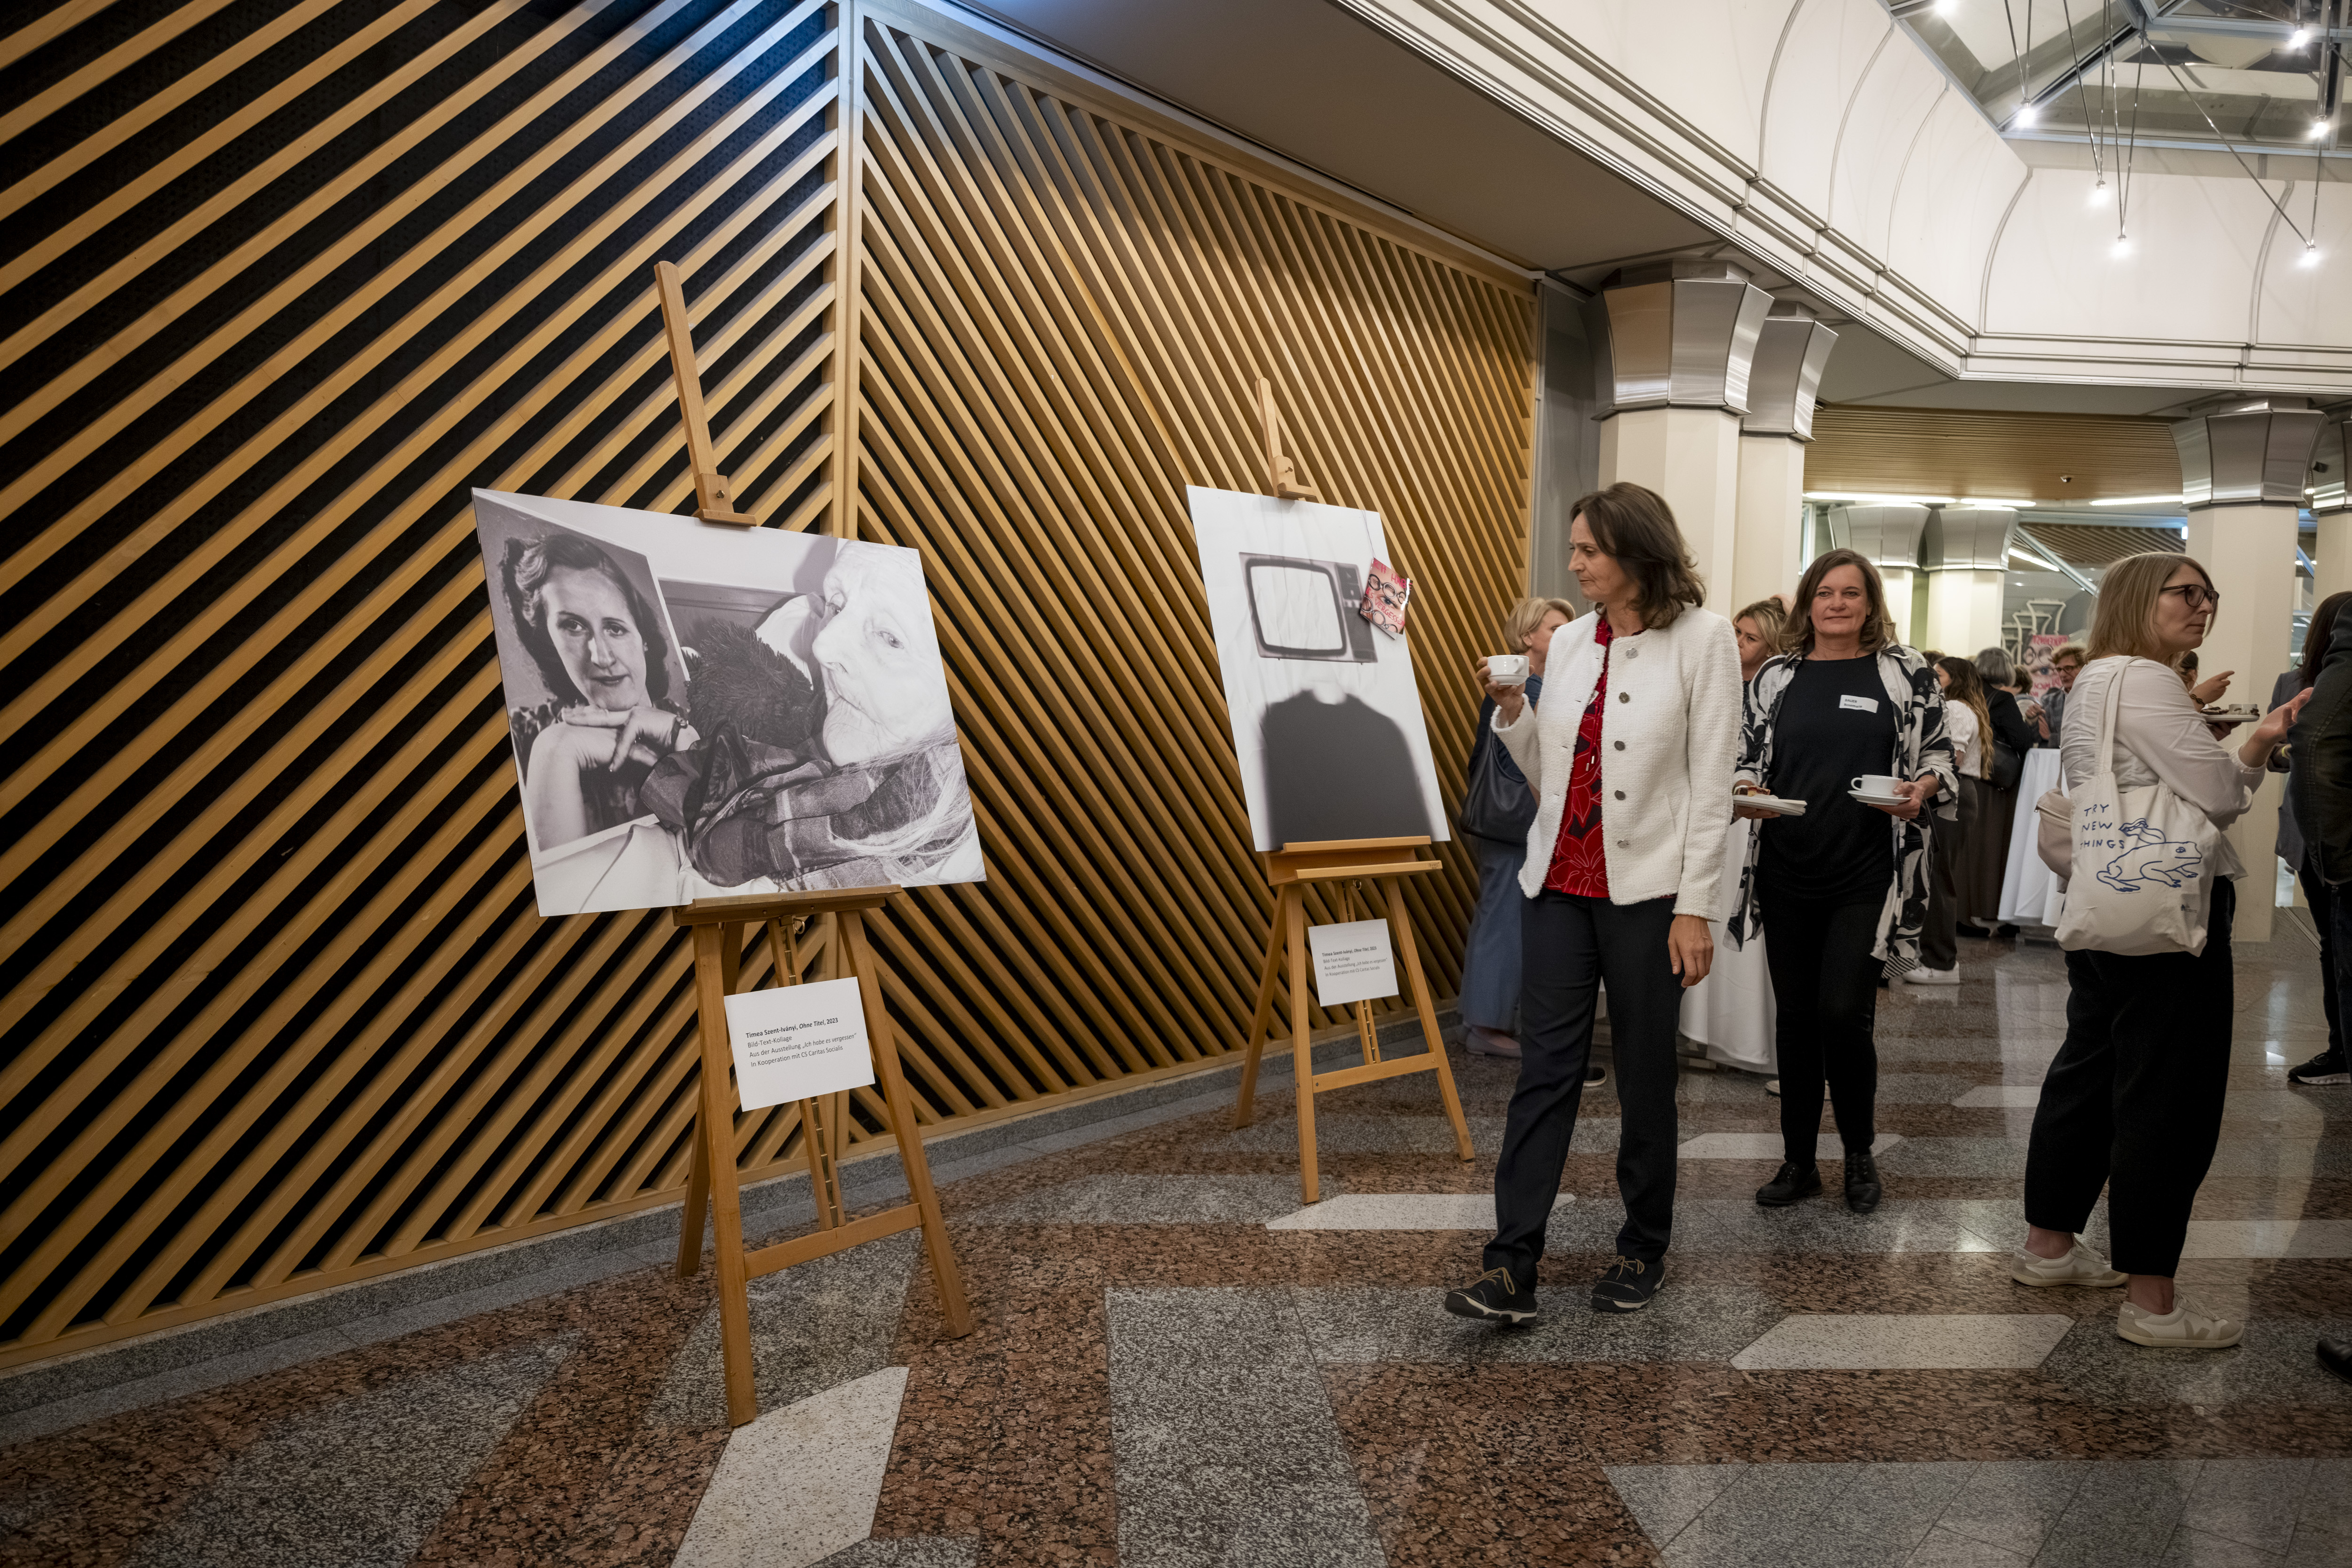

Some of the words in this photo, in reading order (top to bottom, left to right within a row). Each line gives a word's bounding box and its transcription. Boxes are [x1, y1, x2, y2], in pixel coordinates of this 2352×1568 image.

[1366, 587, 1375, 598] ES
[1375, 597, 1405, 627] VERGESSEN
[2084, 804, 2109, 817] TRY
[2082, 821, 2113, 832] NEW
[764, 1024, 798, 1035] Szent-Iványi,
[747, 1036, 792, 1048] Bild-Text-Kollage
[771, 1044, 802, 1053] Ausstellung
[757, 1056, 791, 1066] Kooperation
